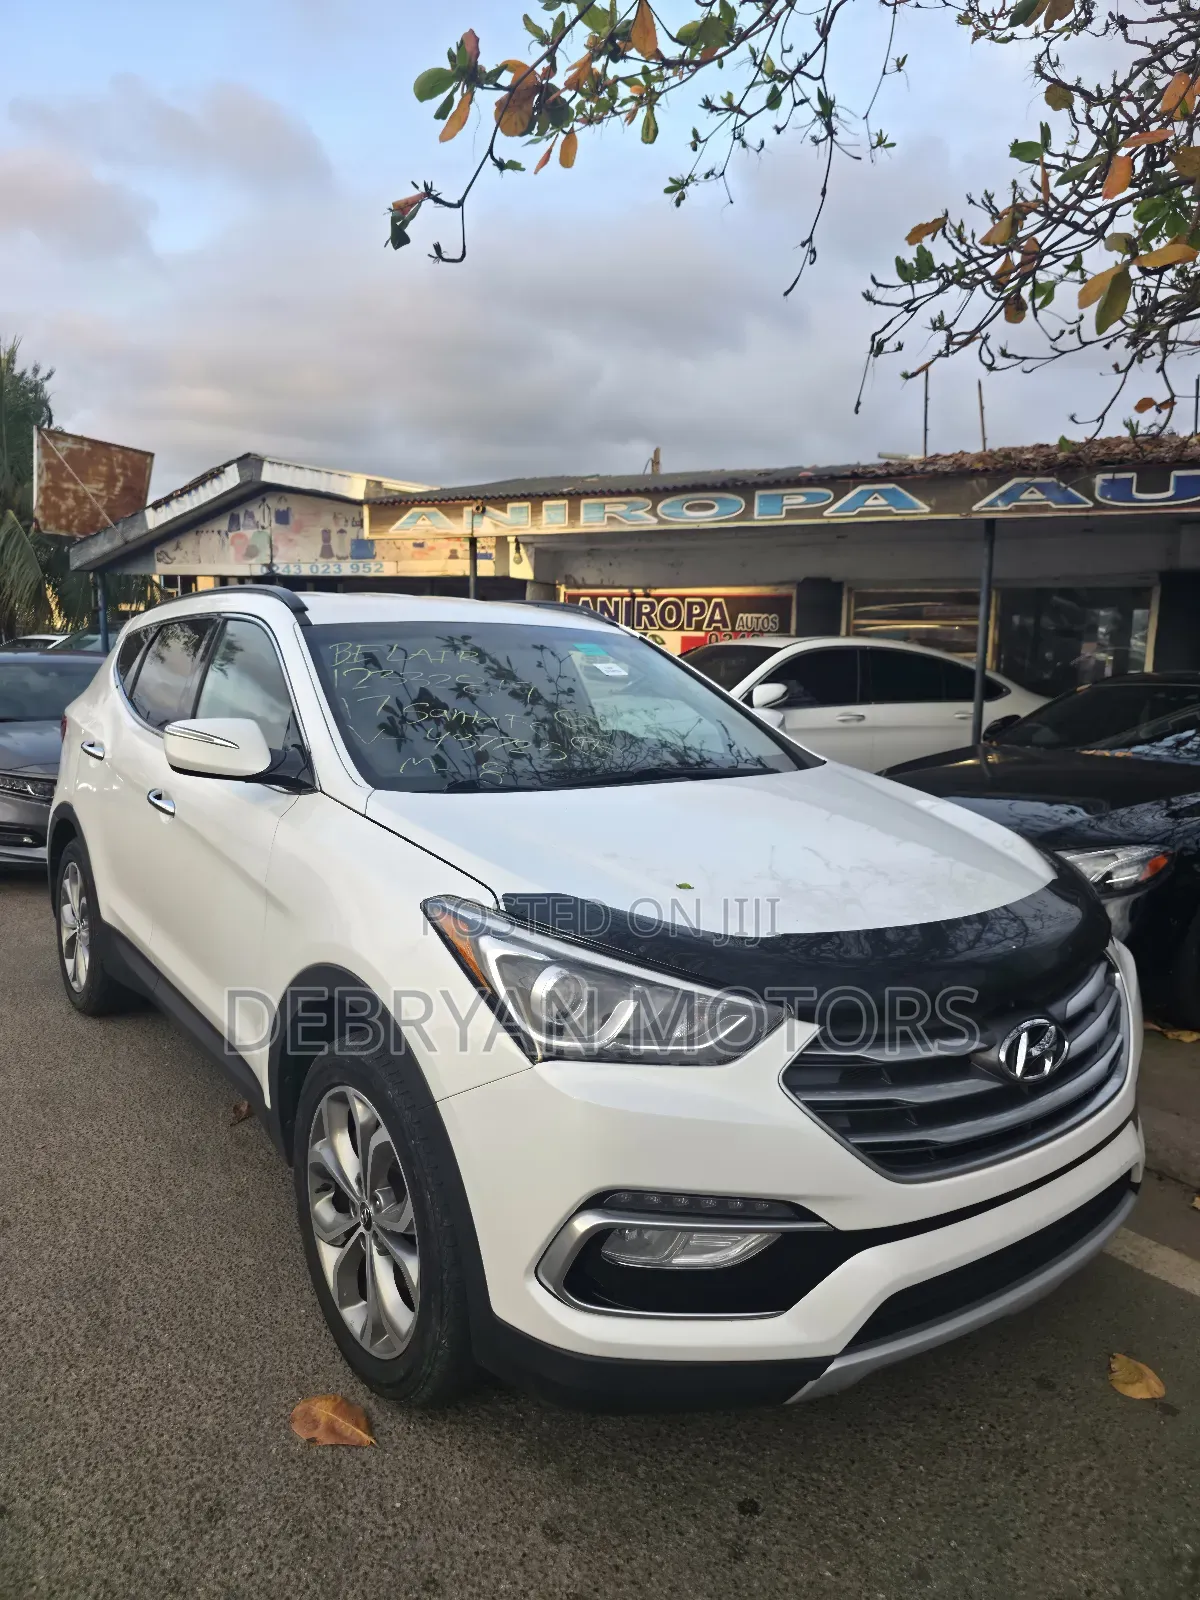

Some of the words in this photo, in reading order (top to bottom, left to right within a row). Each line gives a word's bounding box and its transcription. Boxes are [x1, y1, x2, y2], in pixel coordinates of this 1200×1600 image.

[389, 483, 931, 533] ANIROPA
[310, 564, 342, 575] 023
[350, 563, 384, 574] 952
[735, 613, 779, 631] AUTOS
